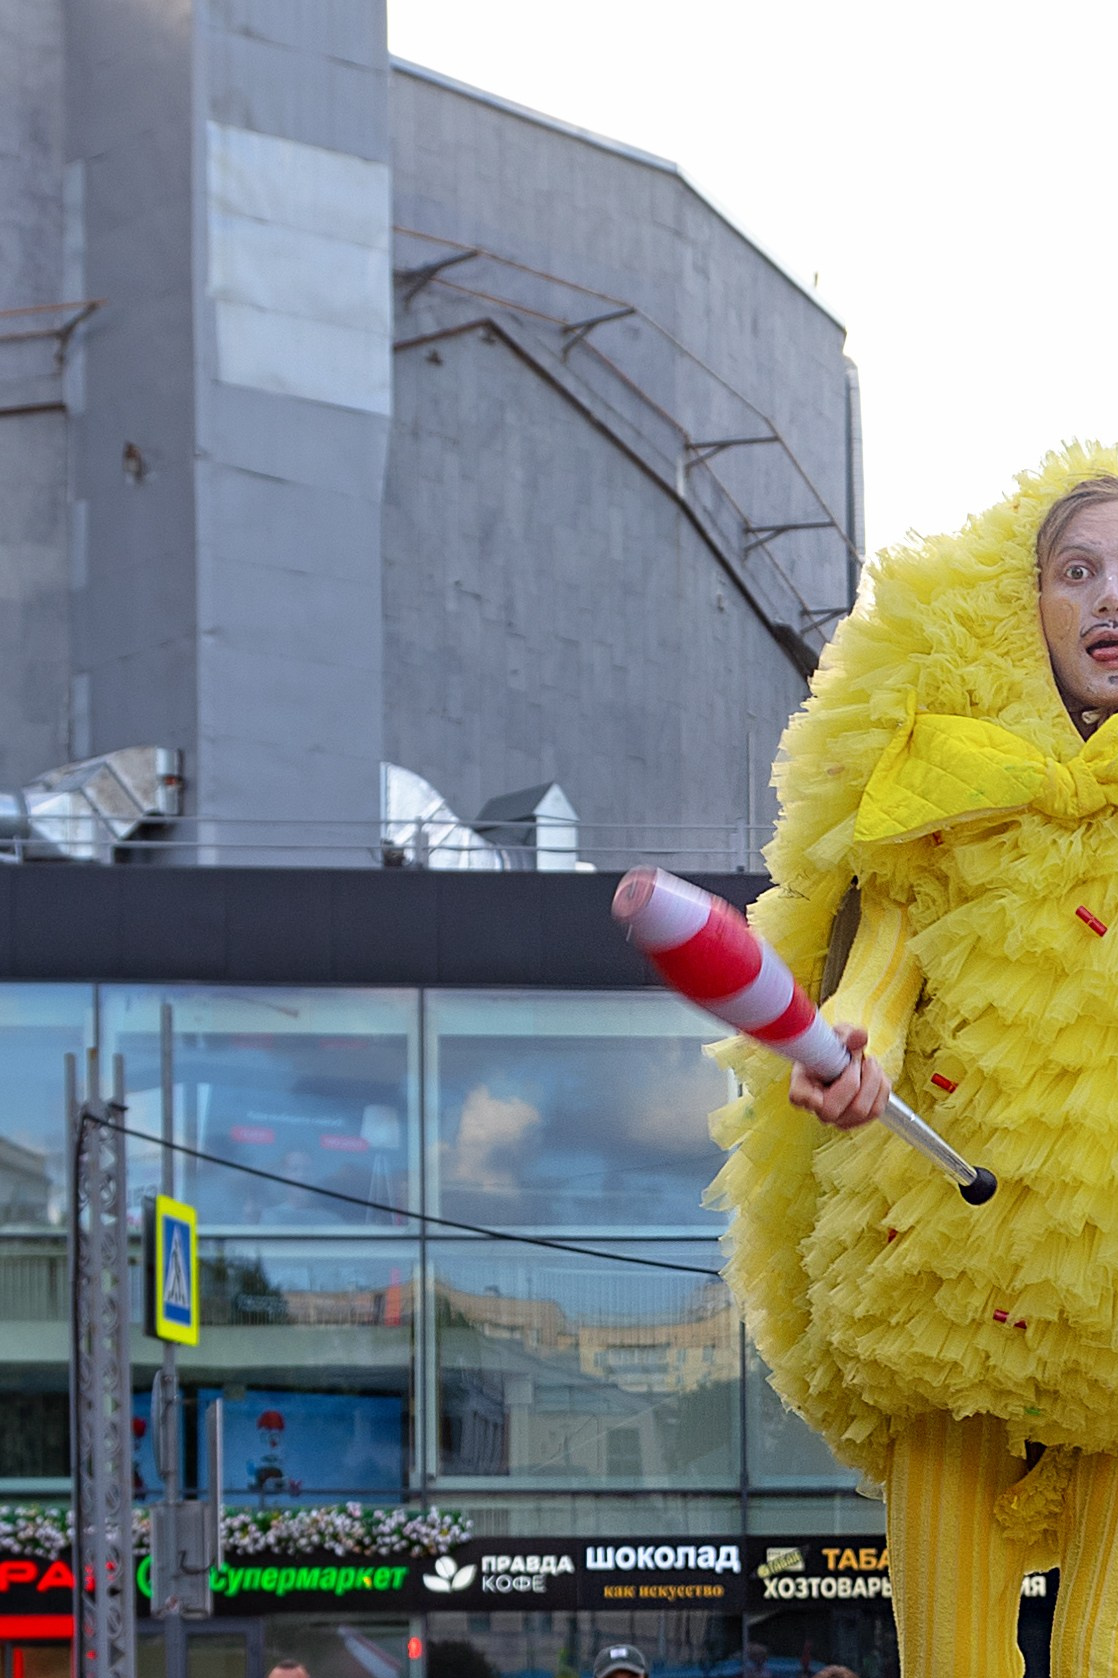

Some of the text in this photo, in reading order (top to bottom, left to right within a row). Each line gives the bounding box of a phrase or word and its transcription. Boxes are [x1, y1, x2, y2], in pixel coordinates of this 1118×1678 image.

[481, 1556, 575, 1577] ПРАВДА
[821, 1548, 889, 1571] ТАБА
[209, 1562, 409, 1597] Супермаркет
[482, 1574, 546, 1593] КОФЕ
[604, 1583, 725, 1601] как искусство
